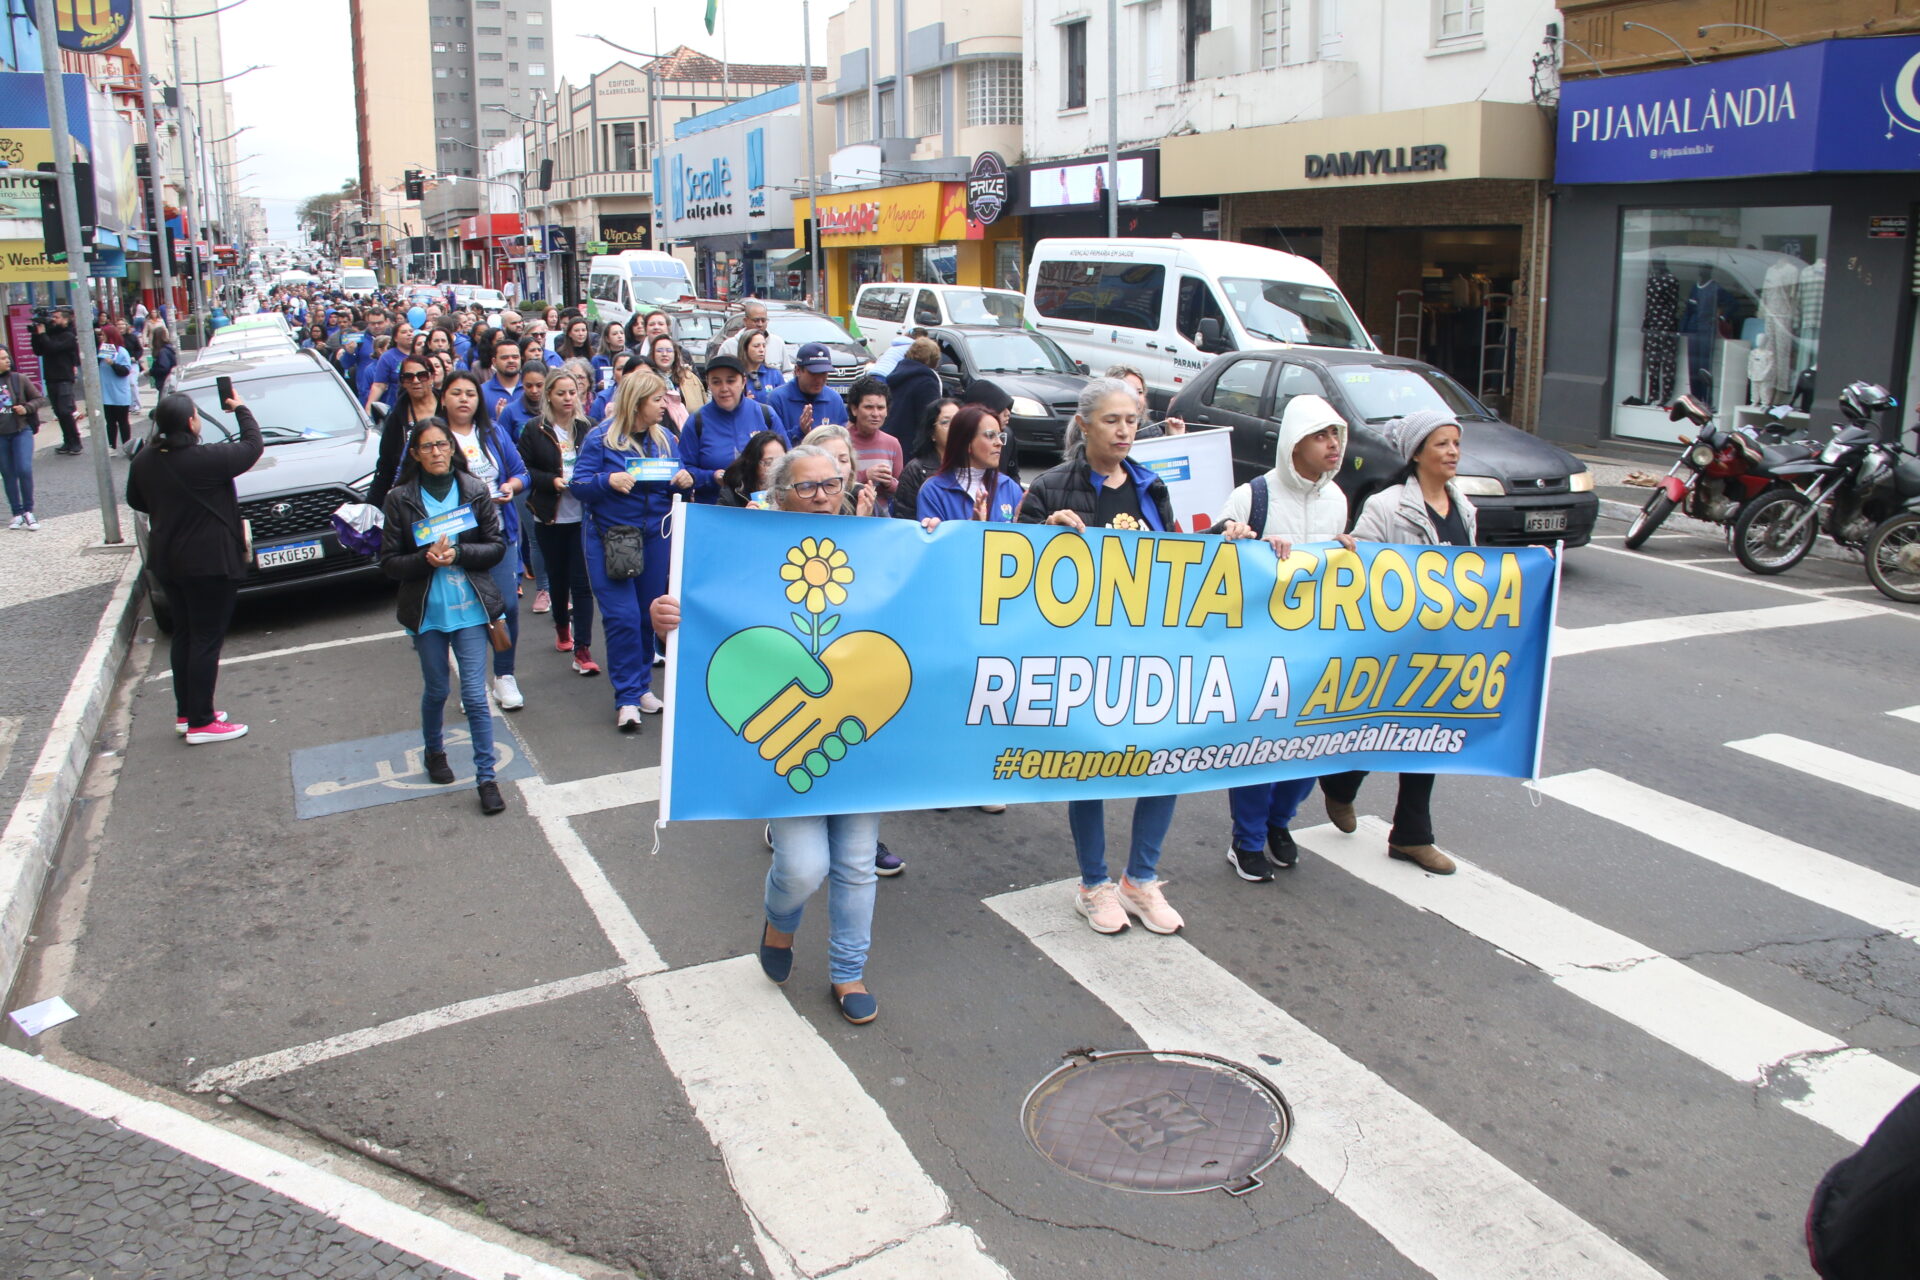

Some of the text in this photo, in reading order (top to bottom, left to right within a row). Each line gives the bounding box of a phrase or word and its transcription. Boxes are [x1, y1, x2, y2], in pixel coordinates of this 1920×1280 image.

[1571, 81, 1797, 143] PIJAMALÂNDIA
[1304, 143, 1448, 179] DAMYLLER
[686, 202, 733, 221] calçados
[970, 178, 1005, 199] PRIZE
[1173, 357, 1202, 371] PARANÁ
[979, 529, 1522, 633] PONTA GROSSA
[965, 650, 1511, 727] REPUDIA A ADI 7796
[993, 722, 1467, 781] #euapoioasescolasespecializadas
